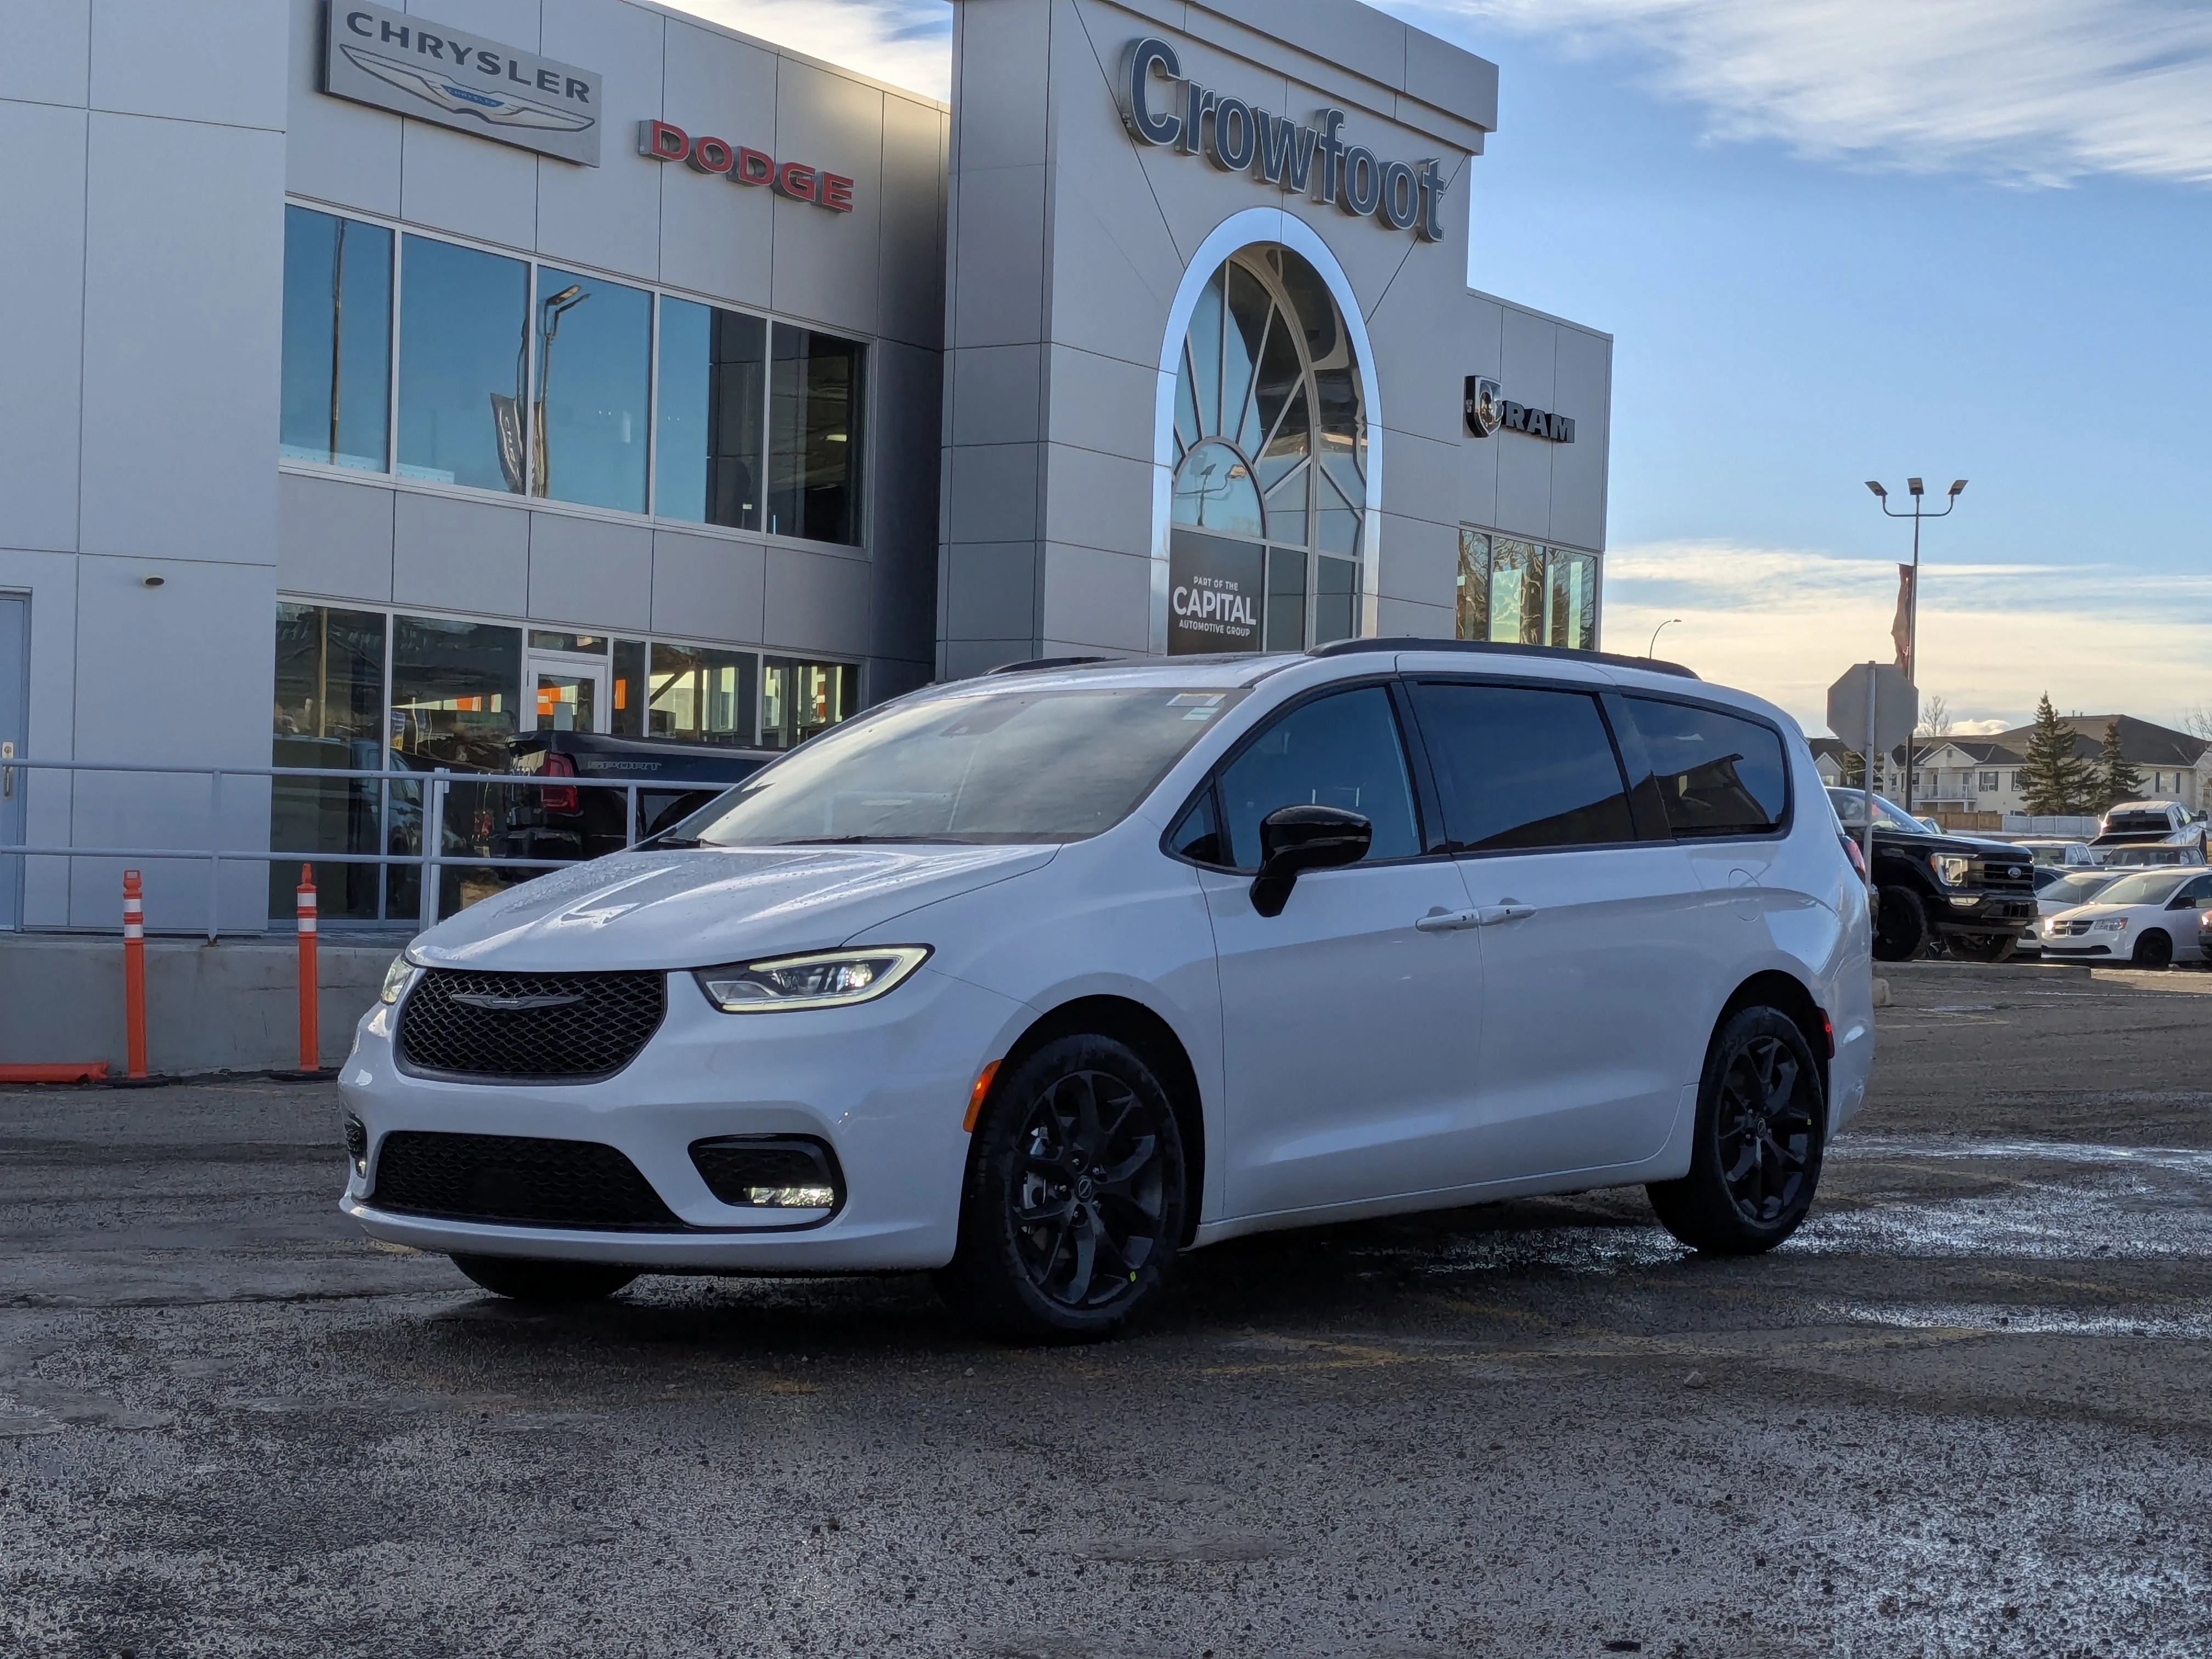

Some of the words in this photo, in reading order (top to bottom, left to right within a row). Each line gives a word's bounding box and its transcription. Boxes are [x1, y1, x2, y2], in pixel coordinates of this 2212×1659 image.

[347, 12, 590, 103] CHRYSLER
[1125, 36, 1446, 242] Crowfoot
[647, 119, 854, 213] DODGE
[1505, 400, 1575, 443] RAM
[1193, 575, 1212, 588] PART
[1214, 579, 1223, 589] OF
[1225, 580, 1239, 591] THE
[1173, 586, 1256, 625] CAPITAL
[1179, 619, 1225, 634] AUTOMOTIVE
[1226, 625, 1250, 637] GROUP
